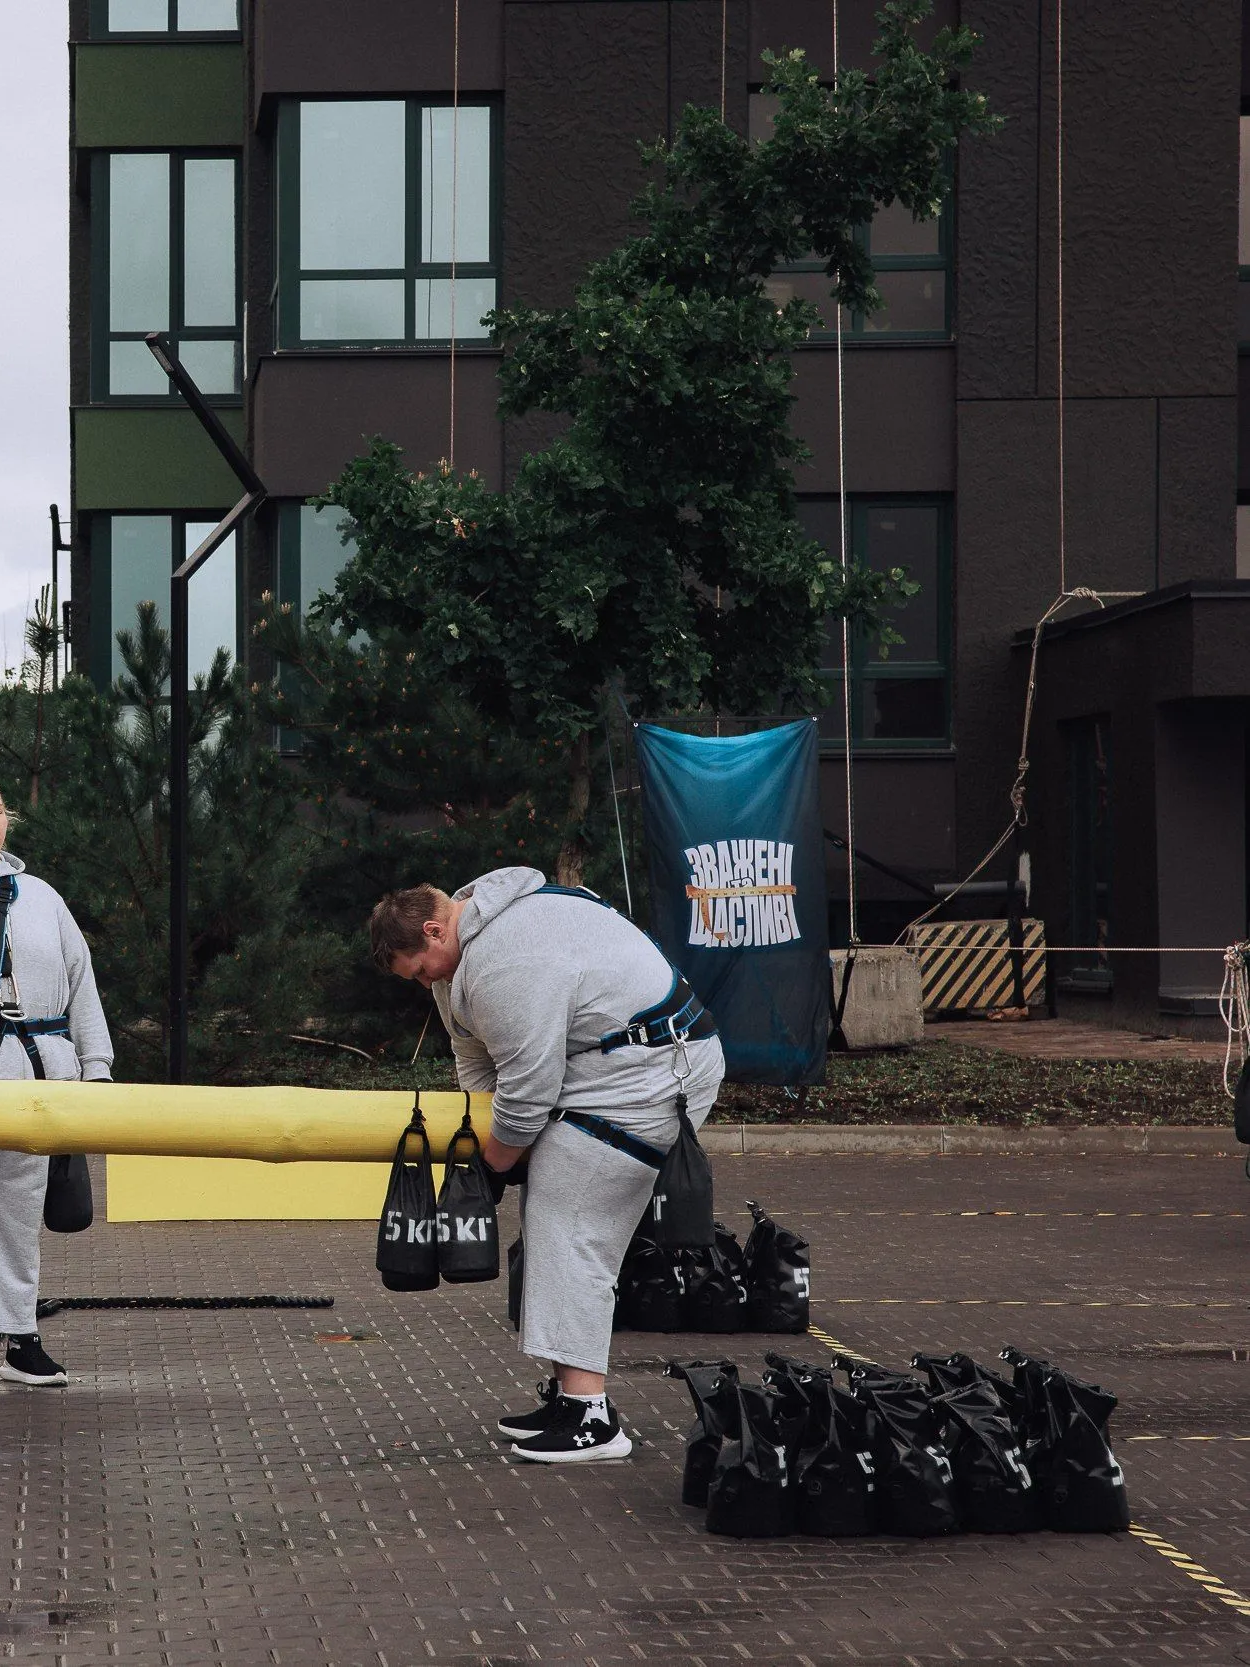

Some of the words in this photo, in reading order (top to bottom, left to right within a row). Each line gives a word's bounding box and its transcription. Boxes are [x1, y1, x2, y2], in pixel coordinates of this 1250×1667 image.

[684, 839, 794, 889] ЗВАЖЕНІ
[688, 894, 801, 948] ЩАСЛИВІ
[385, 1211, 402, 1241] 5
[436, 1212, 450, 1242] 5
[674, 1266, 686, 1294] 5
[732, 1275, 747, 1303] 5
[794, 1268, 810, 1297] 5
[1005, 1447, 1032, 1489] 5
